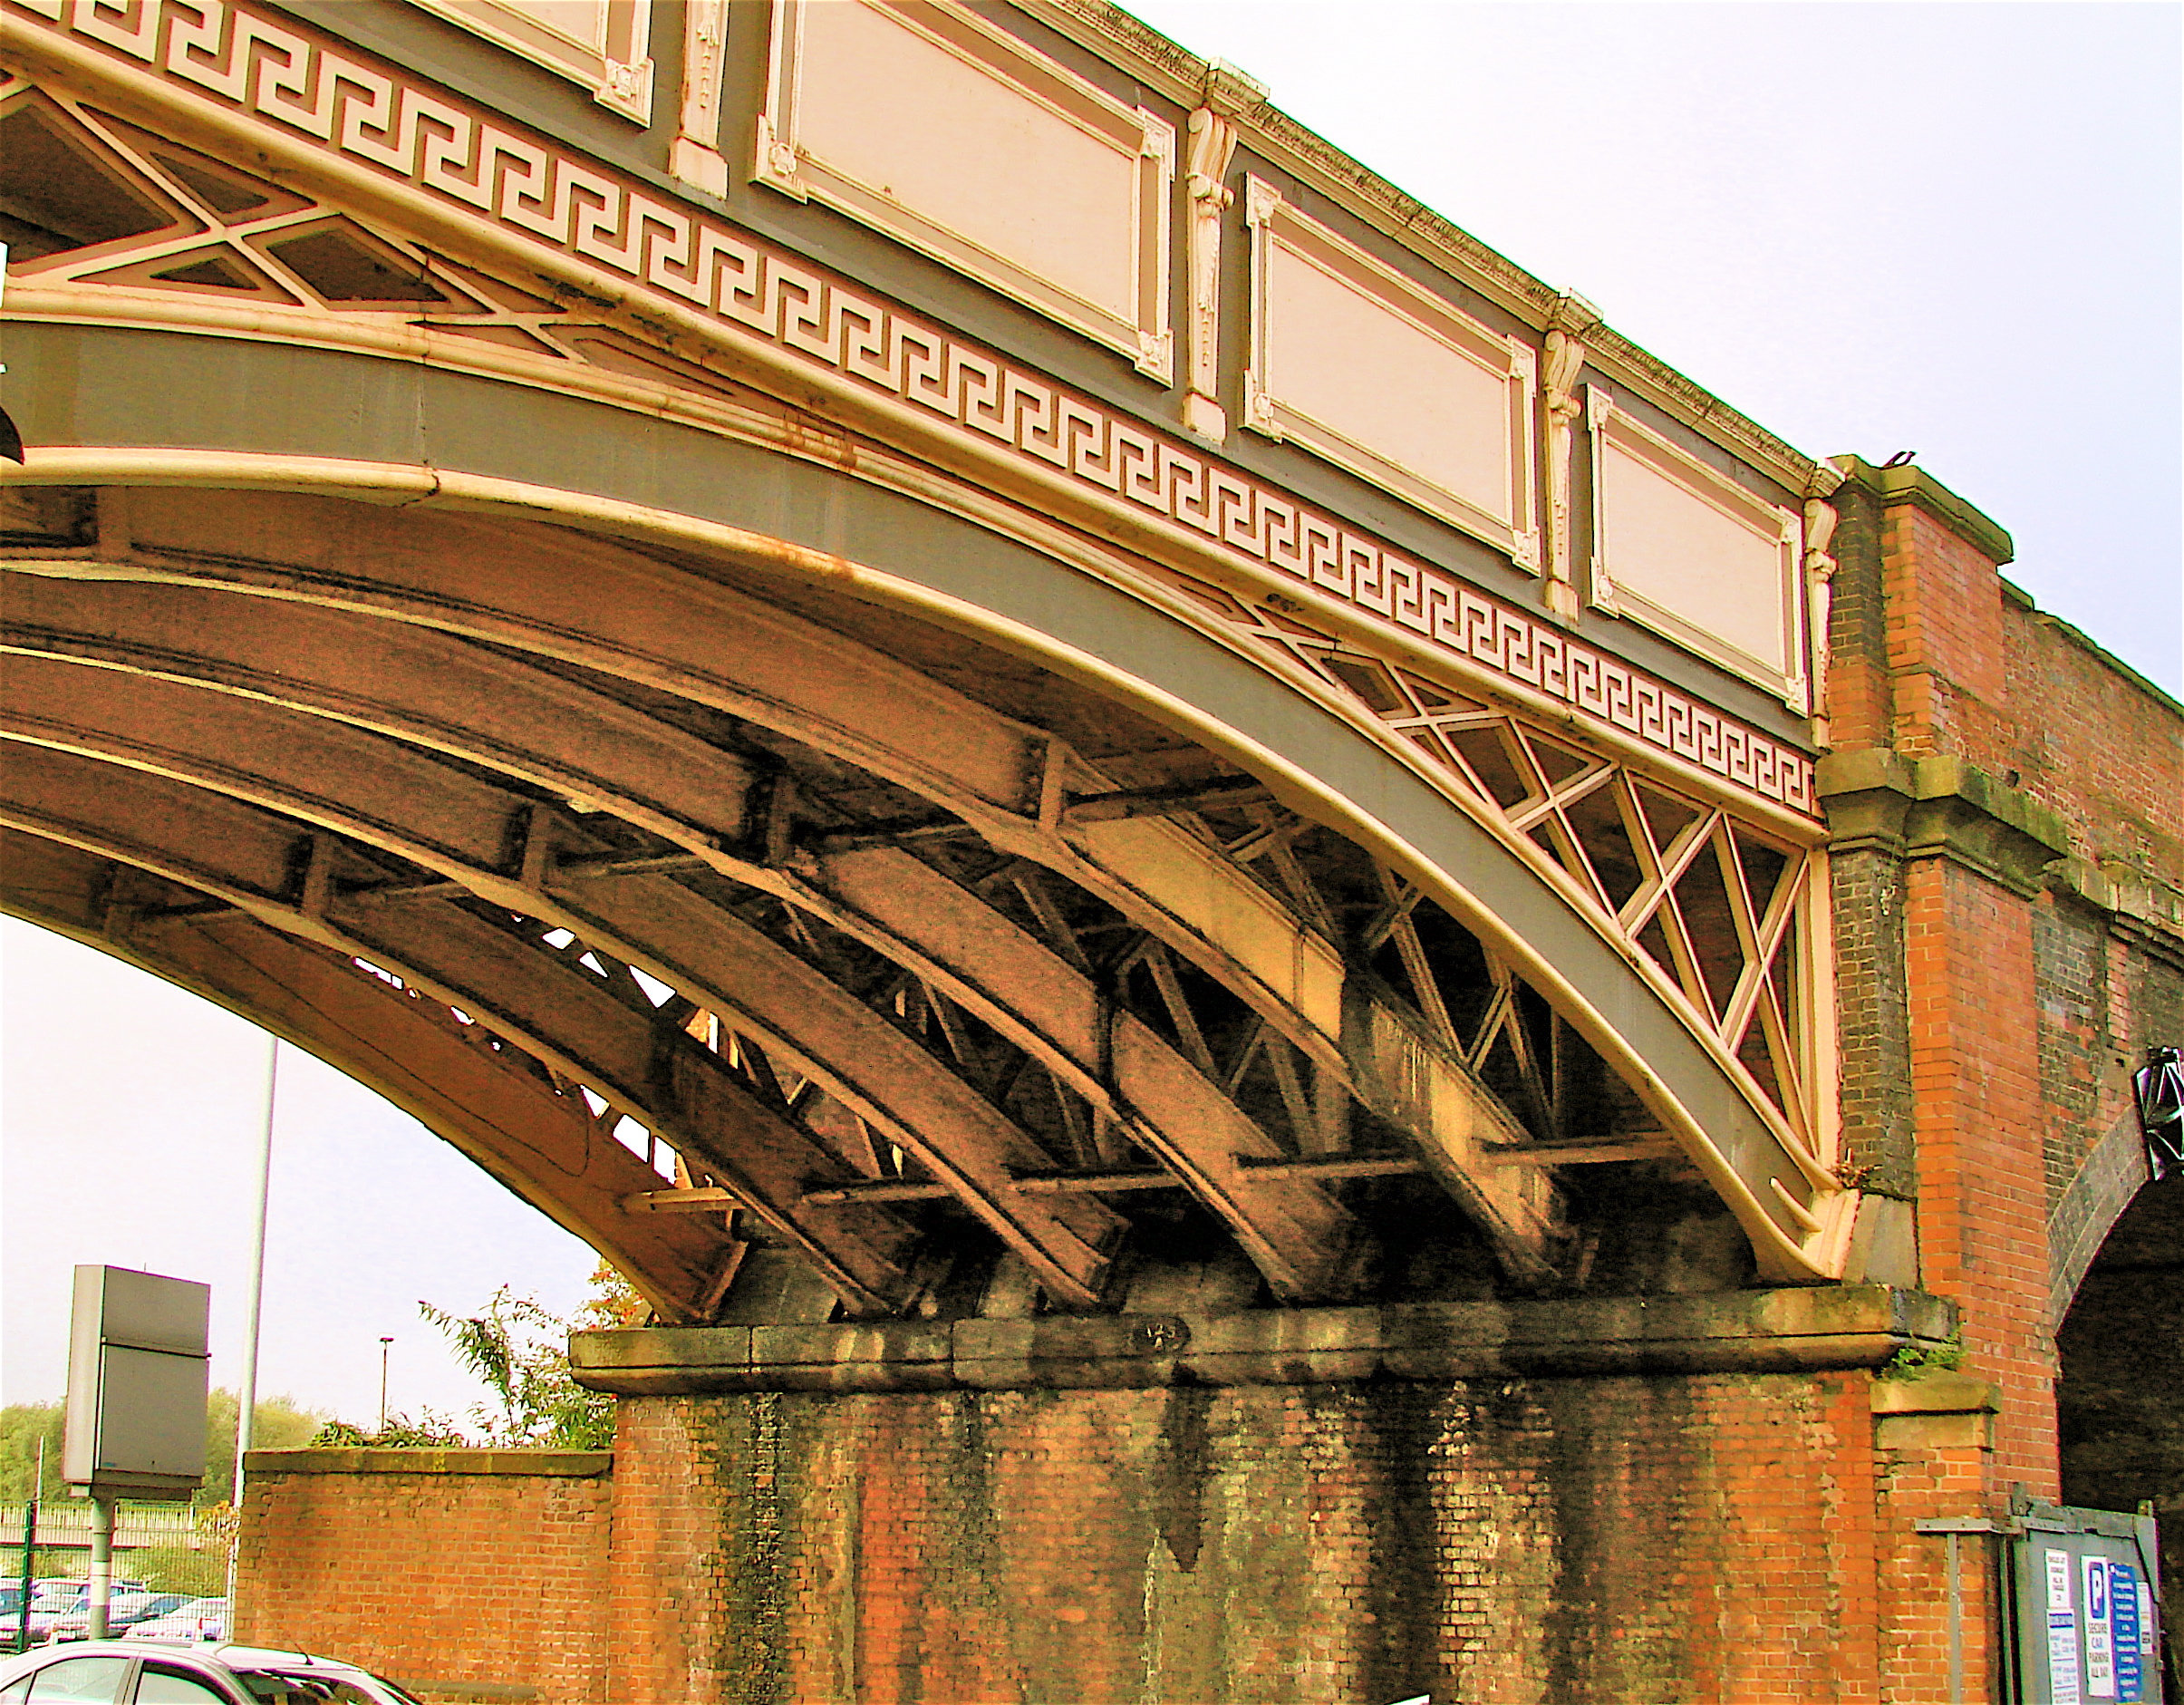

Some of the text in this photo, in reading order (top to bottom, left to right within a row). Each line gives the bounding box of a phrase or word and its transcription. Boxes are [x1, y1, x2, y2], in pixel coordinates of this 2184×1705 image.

[2092, 1569, 2103, 1611] P
[2088, 1623, 2108, 1633] SECURE
[2092, 1637, 2103, 1649] CAR
[2089, 1652, 2109, 1663] PARKING
